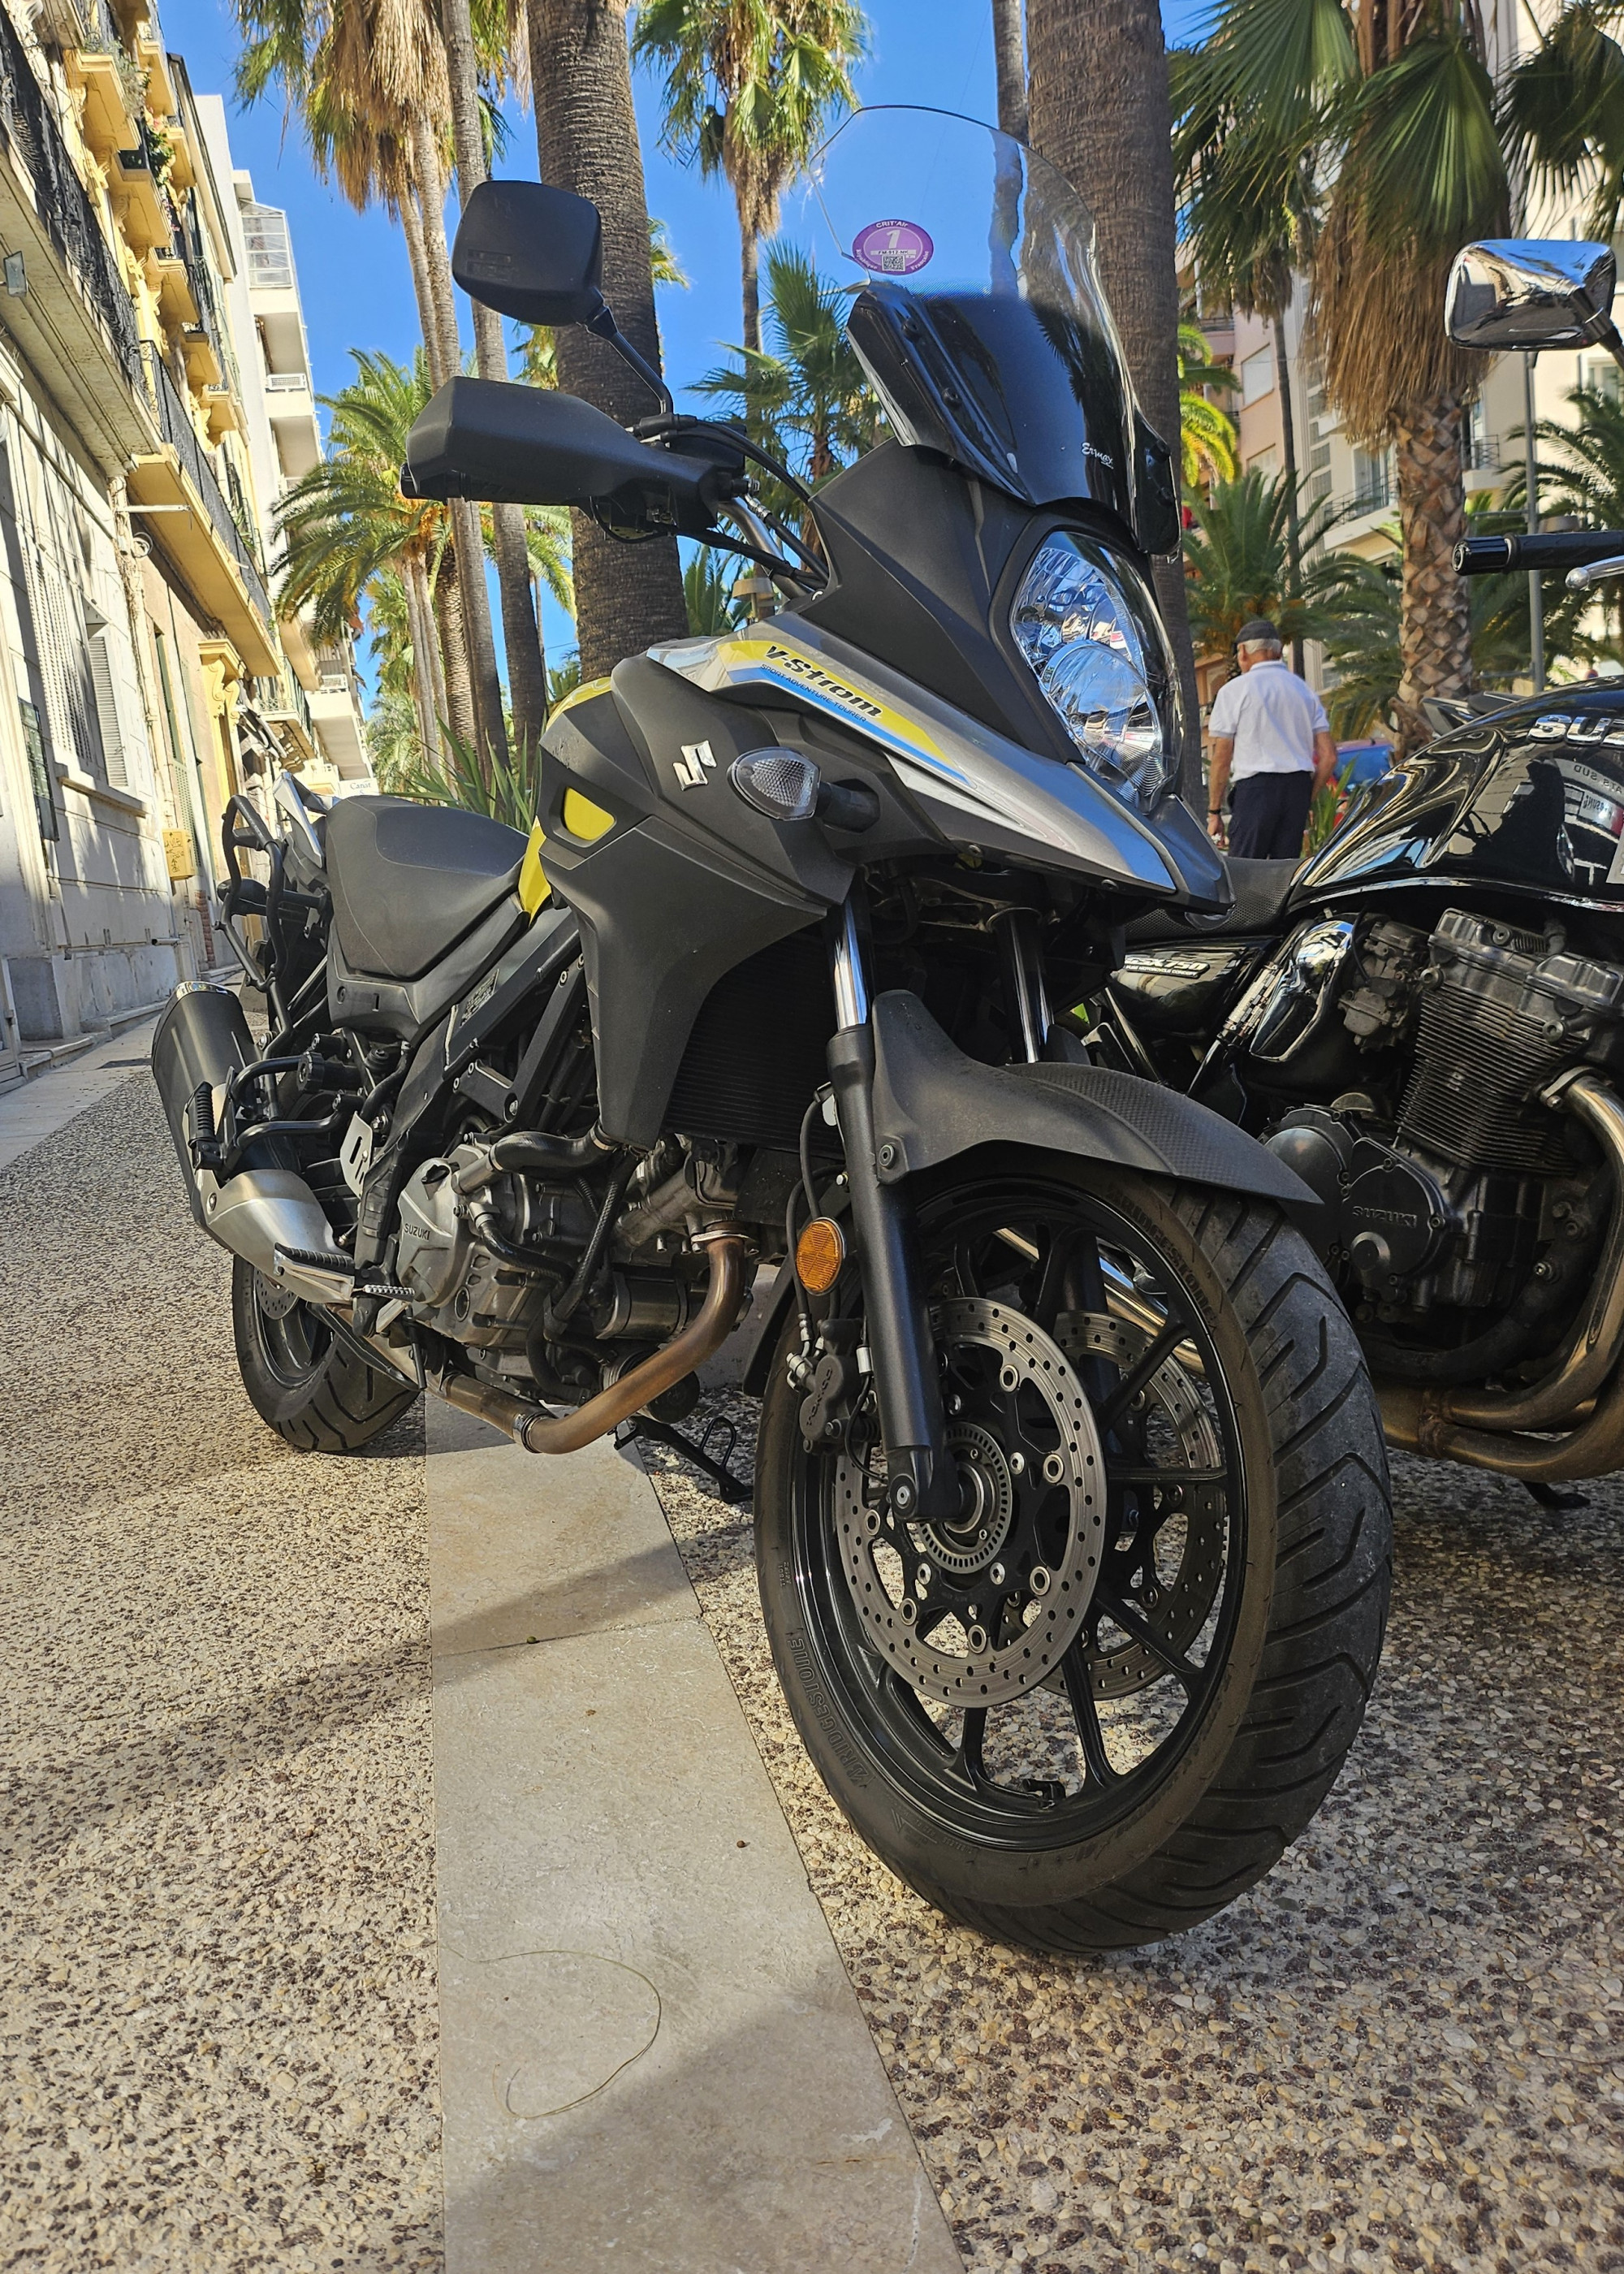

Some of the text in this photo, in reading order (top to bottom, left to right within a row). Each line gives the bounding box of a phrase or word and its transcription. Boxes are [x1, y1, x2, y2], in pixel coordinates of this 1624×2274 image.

[887, 230, 901, 249] 1
[1082, 443, 1113, 465] Ermax
[765, 645, 883, 718] V-Strom
[760, 664, 867, 722] SPORT ADVENTURE TOURER
[1352, 1206, 1417, 1228] SUZUKI
[404, 1223, 430, 1240] SUZUKI
[786, 1637, 870, 1783] BRIDGESTONE
